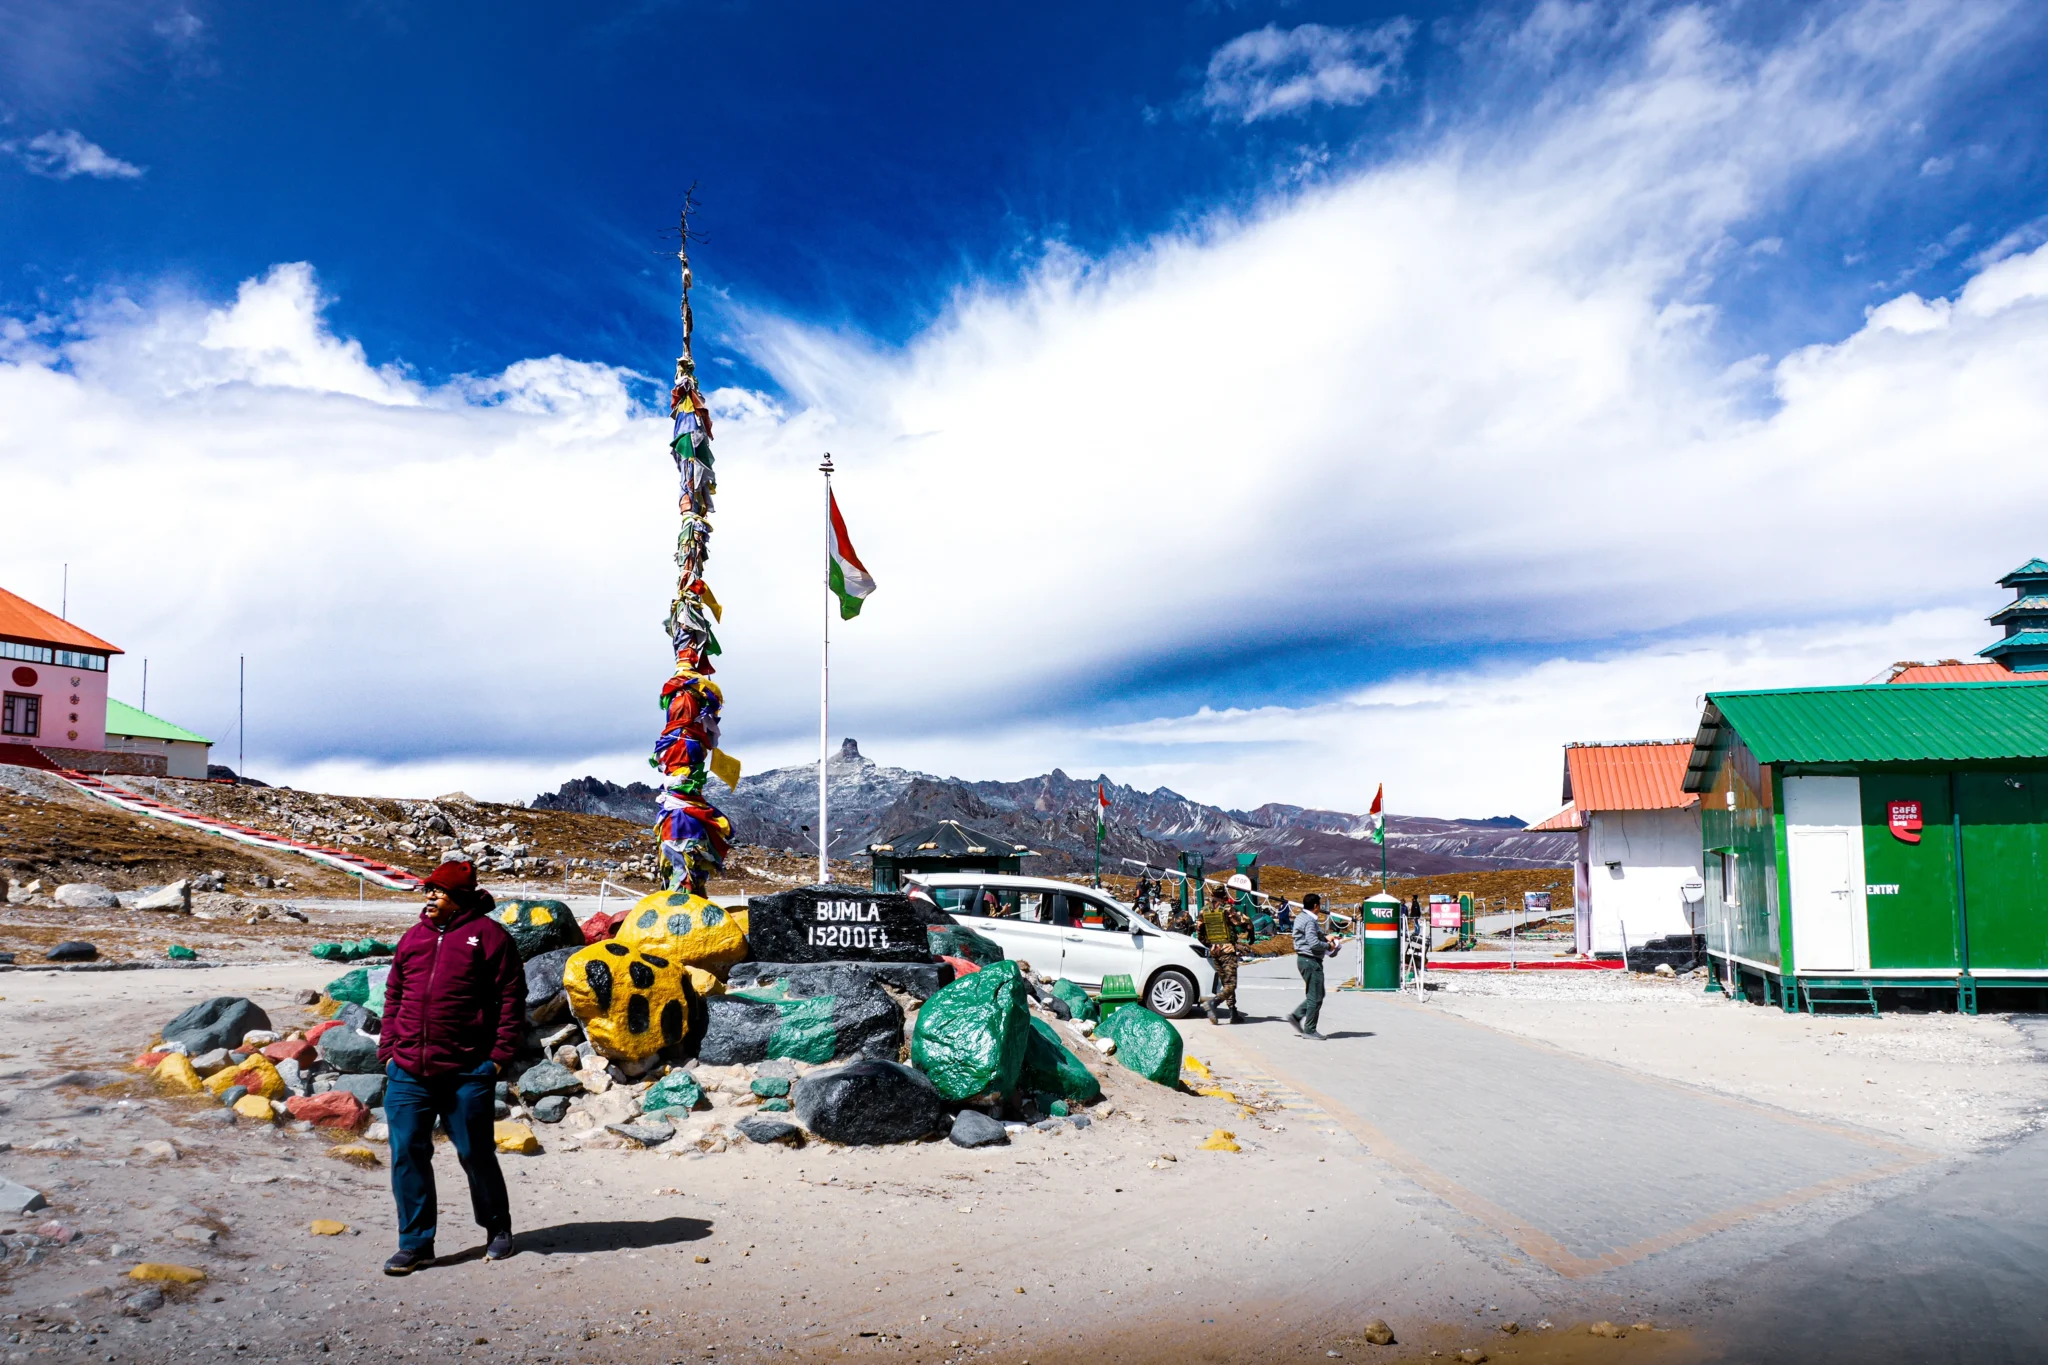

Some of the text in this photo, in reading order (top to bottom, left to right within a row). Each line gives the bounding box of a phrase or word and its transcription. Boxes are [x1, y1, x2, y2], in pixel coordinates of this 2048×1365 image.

[1866, 884, 1899, 894] ENTRY
[816, 901, 880, 921] BUMLA
[1371, 908, 1393, 918] भारत
